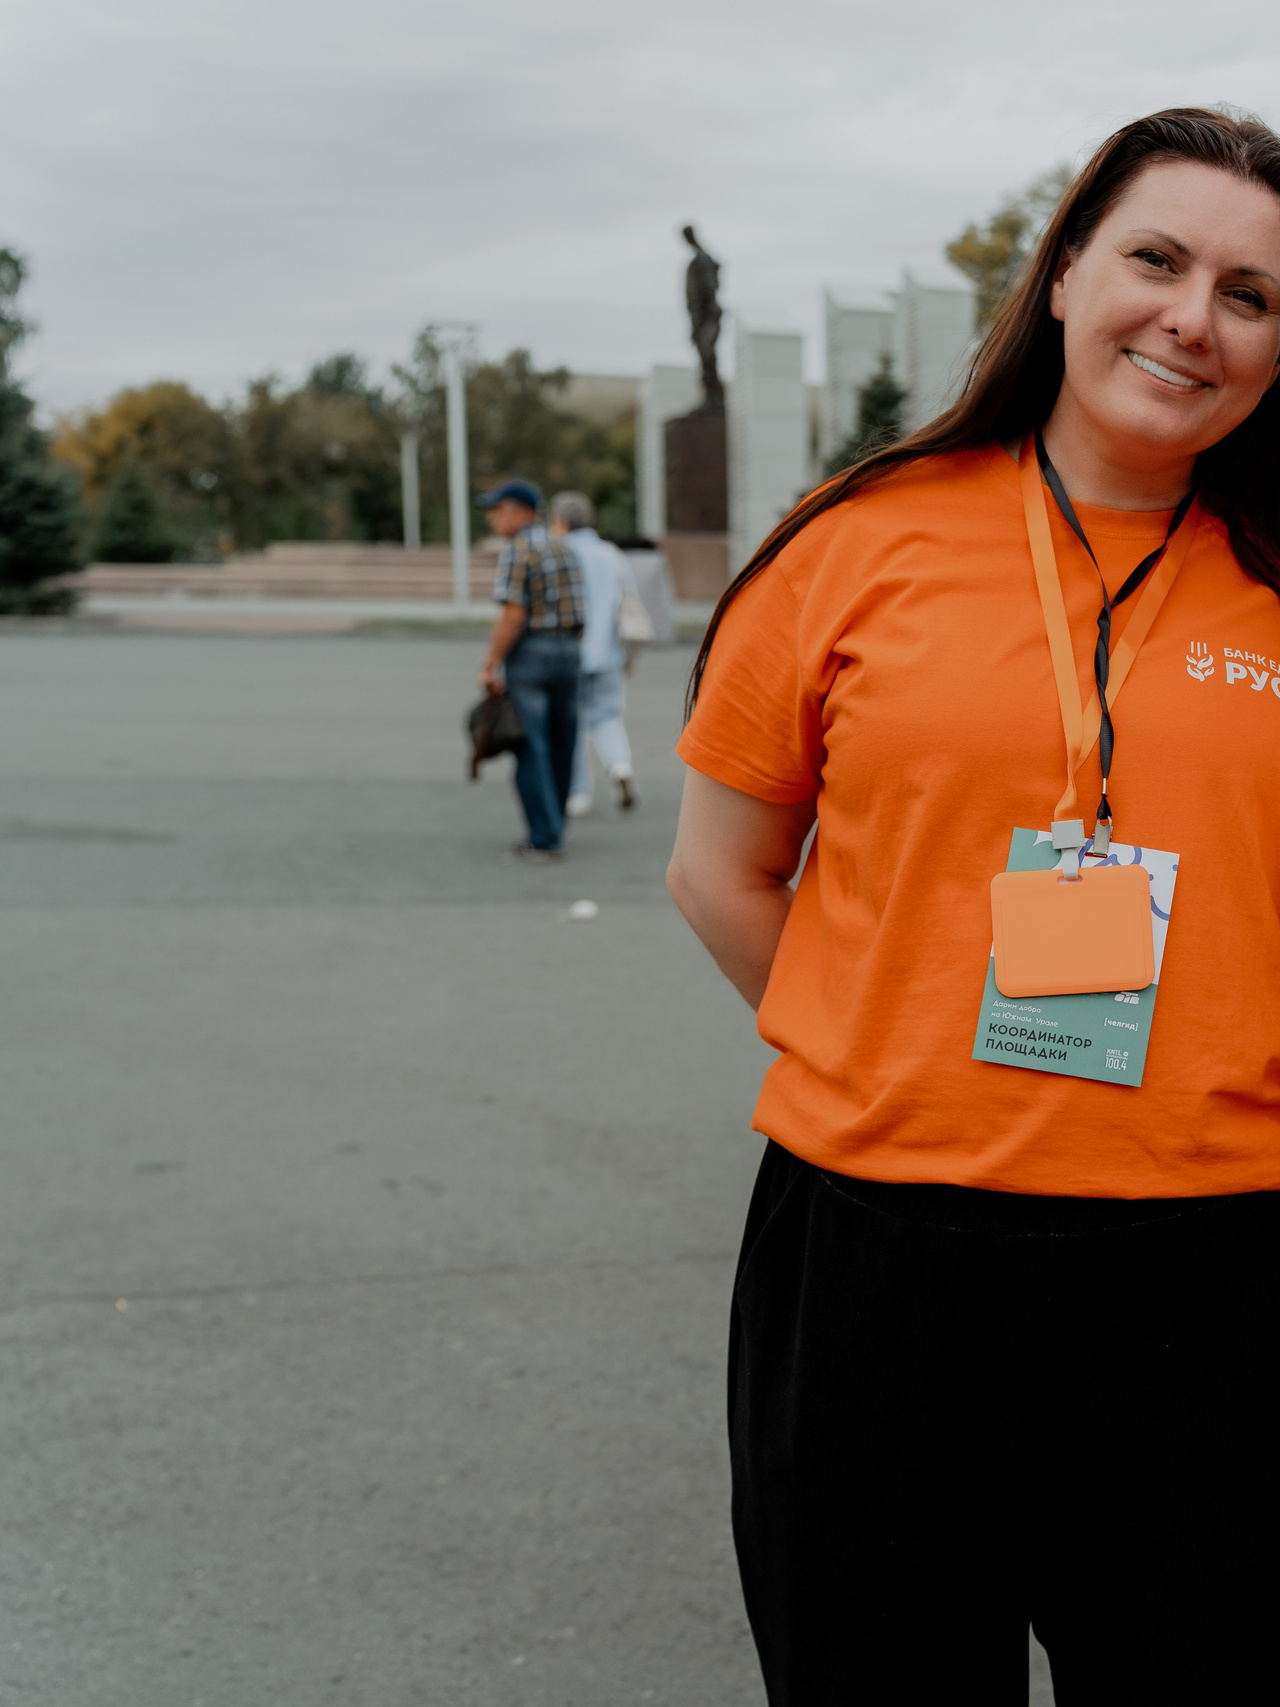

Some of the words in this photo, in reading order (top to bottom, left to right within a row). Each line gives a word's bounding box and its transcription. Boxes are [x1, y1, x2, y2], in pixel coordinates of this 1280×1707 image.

[1224, 648, 1266, 667] БАНК
[992, 1000, 1018, 1009] Дарим
[1019, 1006, 1041, 1014] добро
[1002, 1012, 1032, 1022] Южном
[1036, 1018, 1058, 1028] Урале
[989, 1022, 1092, 1048] КООРДИНАТОР
[986, 1038, 1067, 1061] ПЛОЩАДКИ
[1106, 1057, 1126, 1070] 100.4
